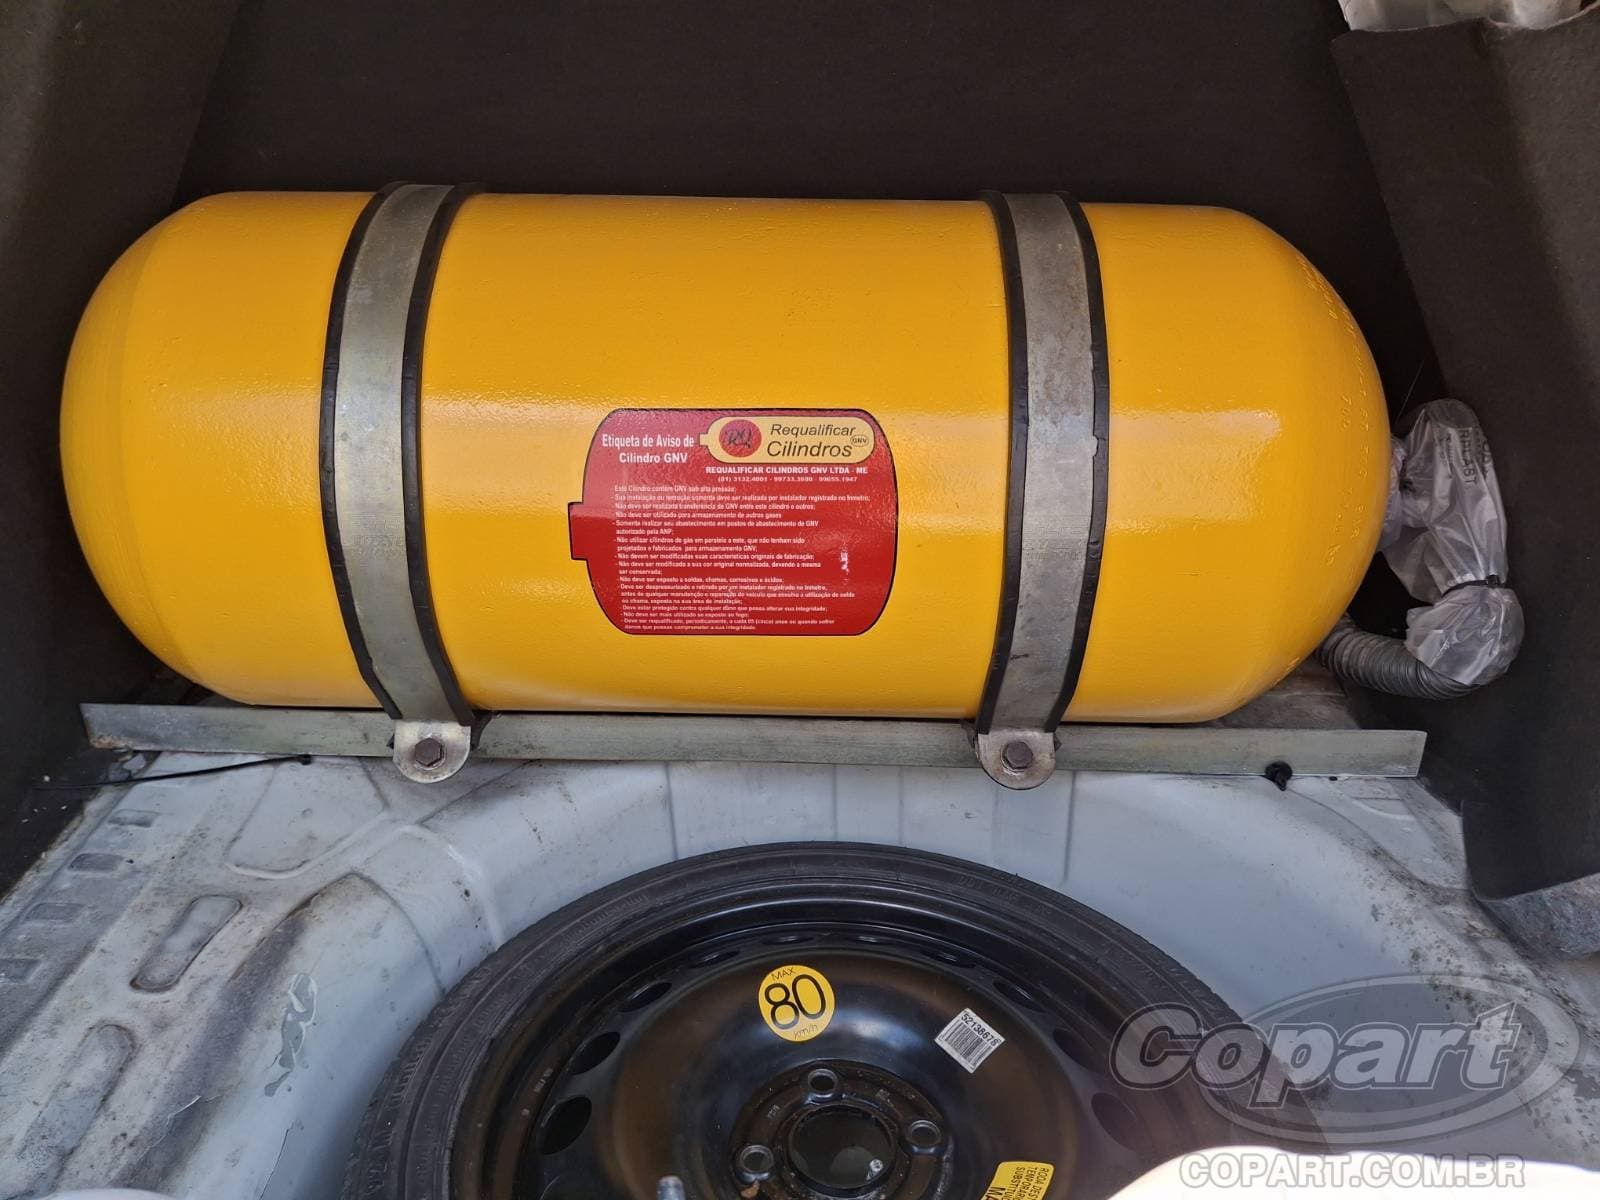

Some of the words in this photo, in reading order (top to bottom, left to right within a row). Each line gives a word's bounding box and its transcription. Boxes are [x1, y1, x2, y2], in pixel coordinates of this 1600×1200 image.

[770, 424, 855, 437] Requalificar
[602, 434, 640, 449] Etiqueta
[643, 434, 653, 447] de
[656, 434, 680, 447] Aviso
[684, 434, 694, 447] de
[767, 441, 852, 457] Cilindros
[619, 453, 660, 463] Cilindro
[664, 453, 688, 463] GNV
[771, 966, 796, 981] MAX
[765, 974, 826, 1030] 80
